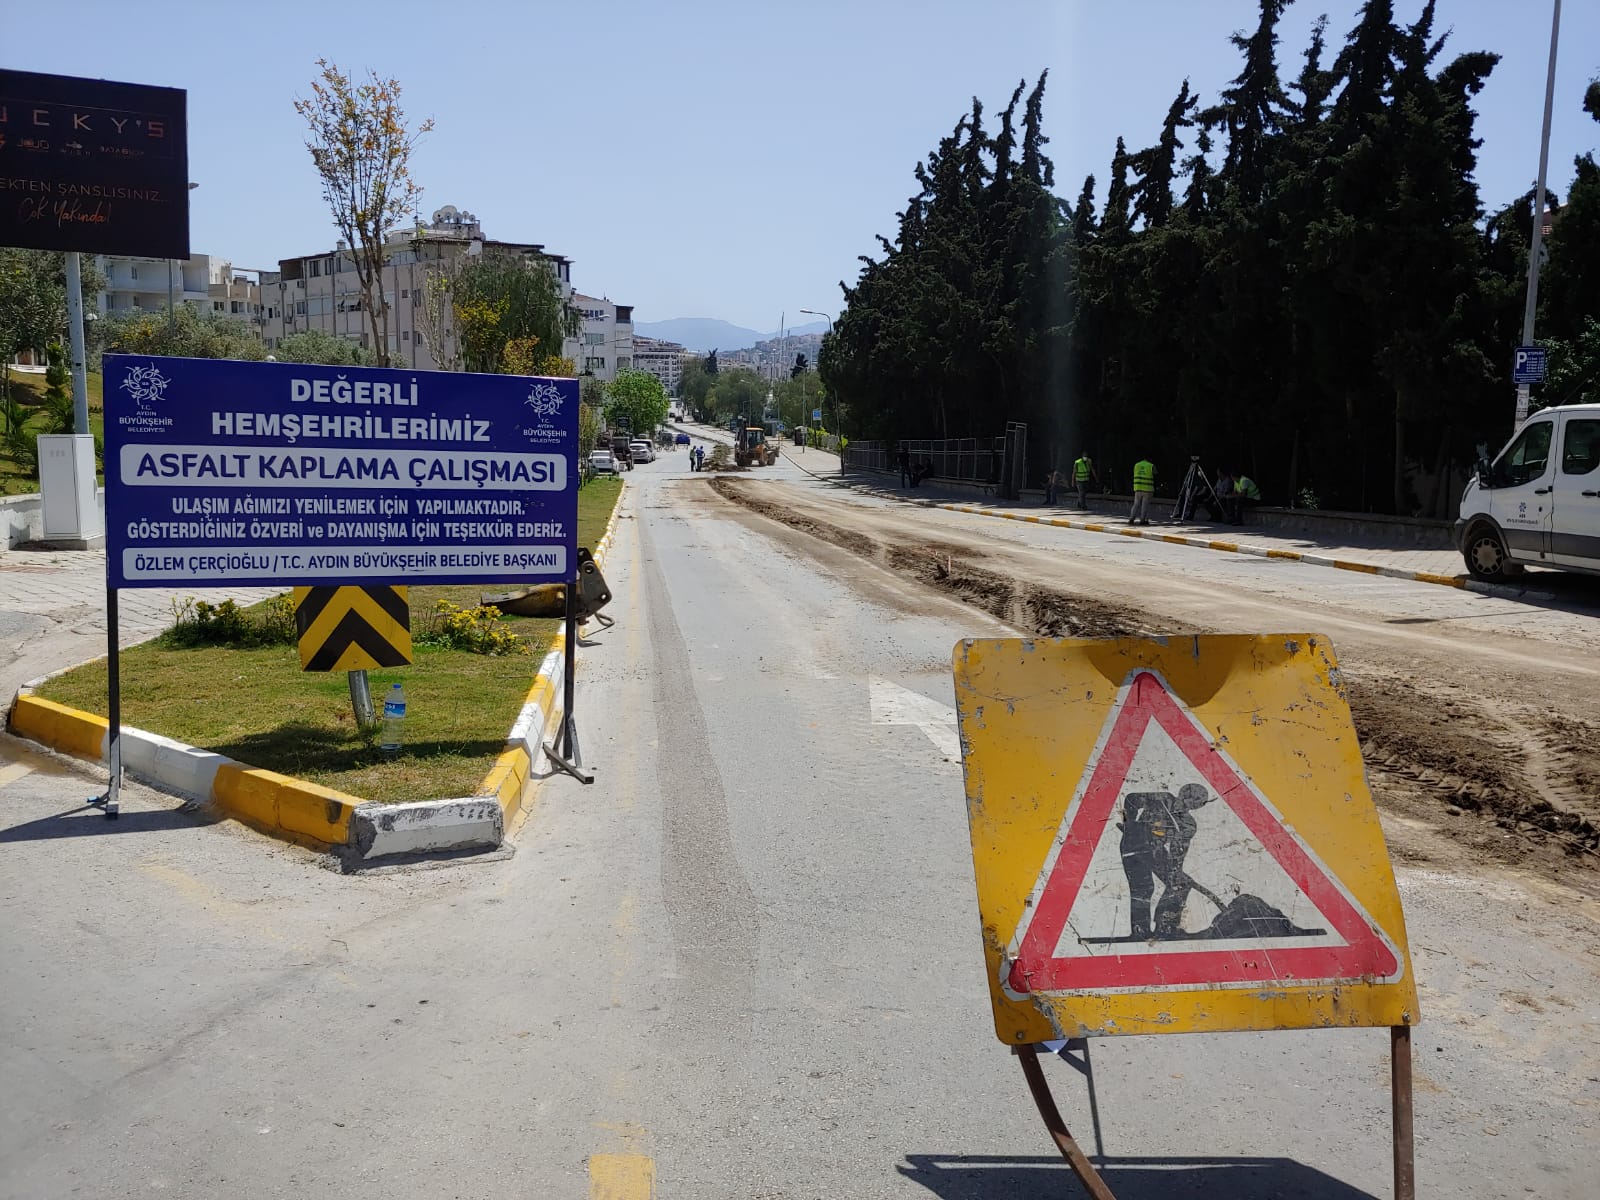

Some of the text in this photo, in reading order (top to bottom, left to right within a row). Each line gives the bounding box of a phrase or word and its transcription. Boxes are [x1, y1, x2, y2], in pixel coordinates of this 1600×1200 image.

[1516, 351, 1528, 369] P
[291, 374, 418, 406] DEĞERLİ
[119, 416, 173, 427] BÜYÜKŞEHİR
[211, 410, 491, 443] HEMŞEHRİLERİMİZ
[523, 428, 567, 438] BÜYÜKŞEHİR
[136, 453, 555, 488] ASFALT KAPLAMA ÇALIŞMASI
[172, 494, 525, 518] ULAŞIM AĞIMIZI YENİLEMEK İÇİN YAPILMAKTADIR.
[127, 517, 567, 541] GÖSTERDİĞİNİZ ÖZVERİ ve DAYANIŞMA İÇİN TEŞEKKÜR EDERİZ.
[135, 554, 184, 571] ÖZLEM
[189, 553, 269, 573] ÇERÇİOĞLU
[281, 555, 304, 569] T.C.
[308, 555, 349, 569] AYDIN
[354, 552, 436, 571] BÜYÜKŞEHİR
[440, 552, 500, 567] BELEDİYE
[503, 553, 557, 569] BAŞKANI
